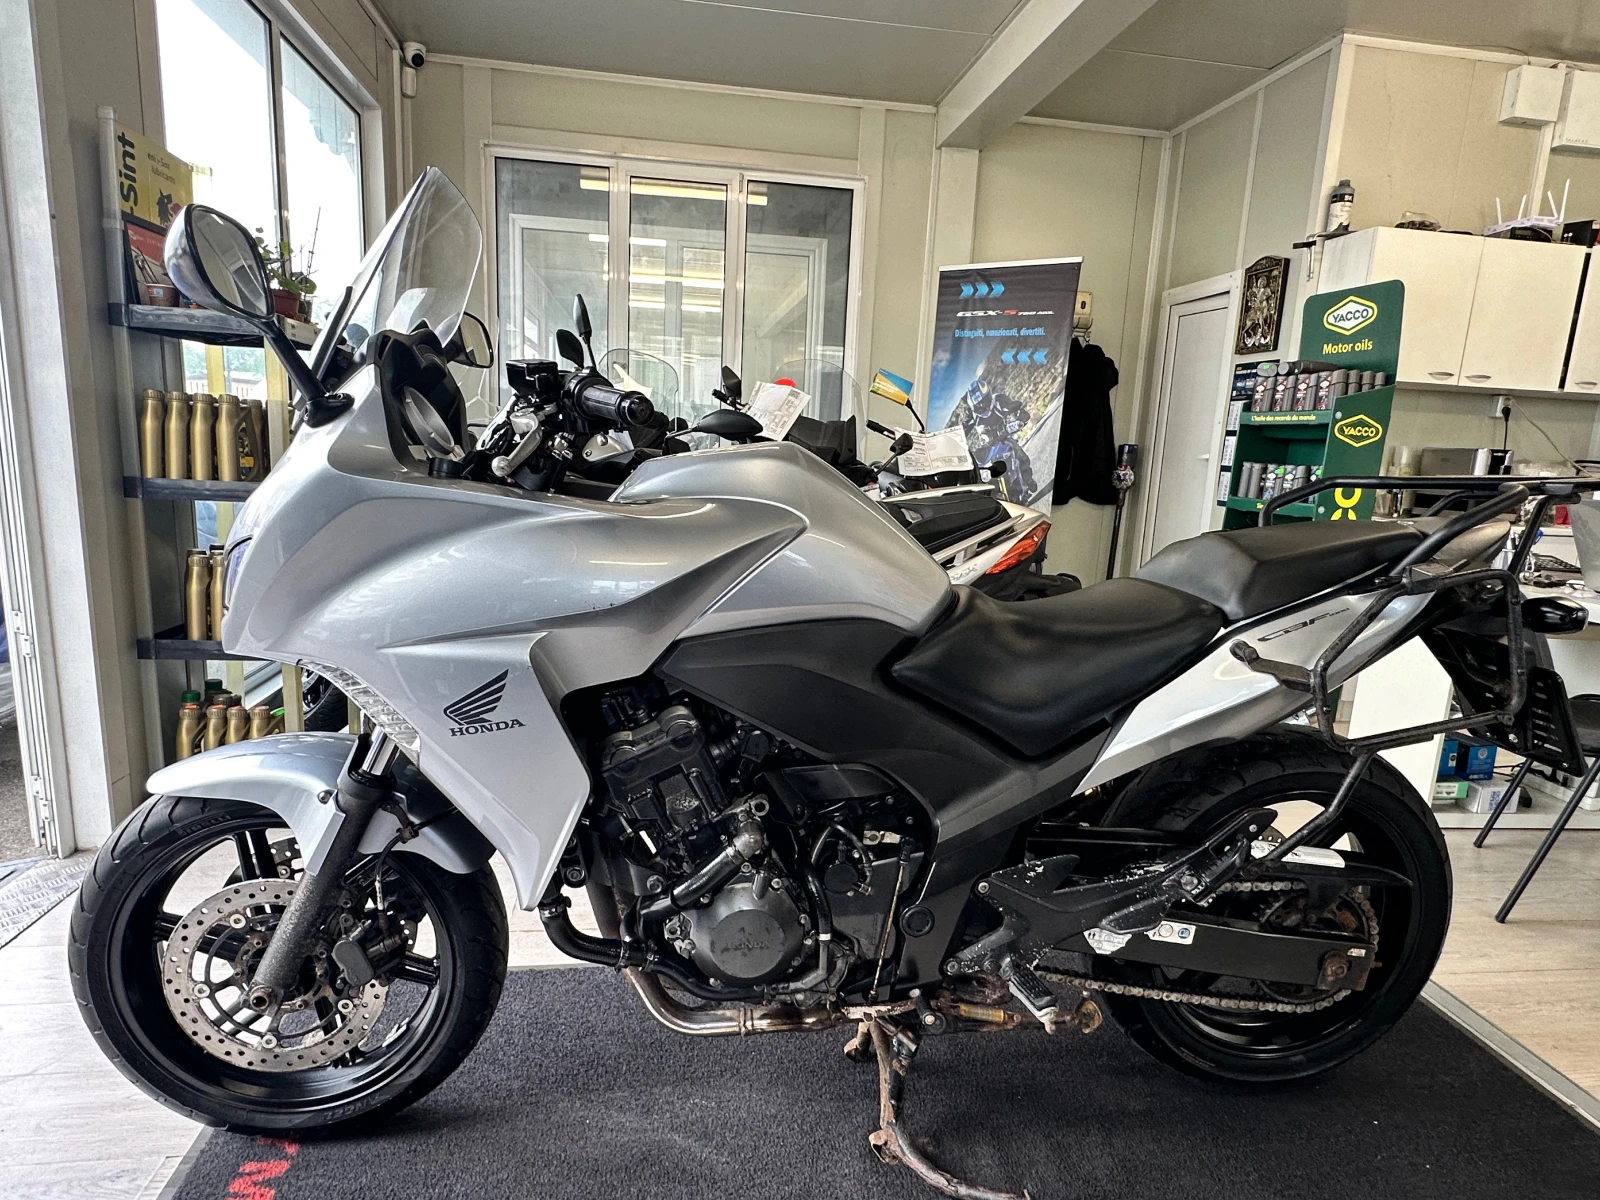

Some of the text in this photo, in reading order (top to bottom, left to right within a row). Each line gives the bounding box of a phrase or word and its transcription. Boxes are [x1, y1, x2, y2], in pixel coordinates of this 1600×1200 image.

[1332, 308, 1370, 323] YACCO
[1322, 339, 1373, 355] Motor oils
[1341, 426, 1376, 437] YACCO
[449, 719, 526, 737] HONDA
